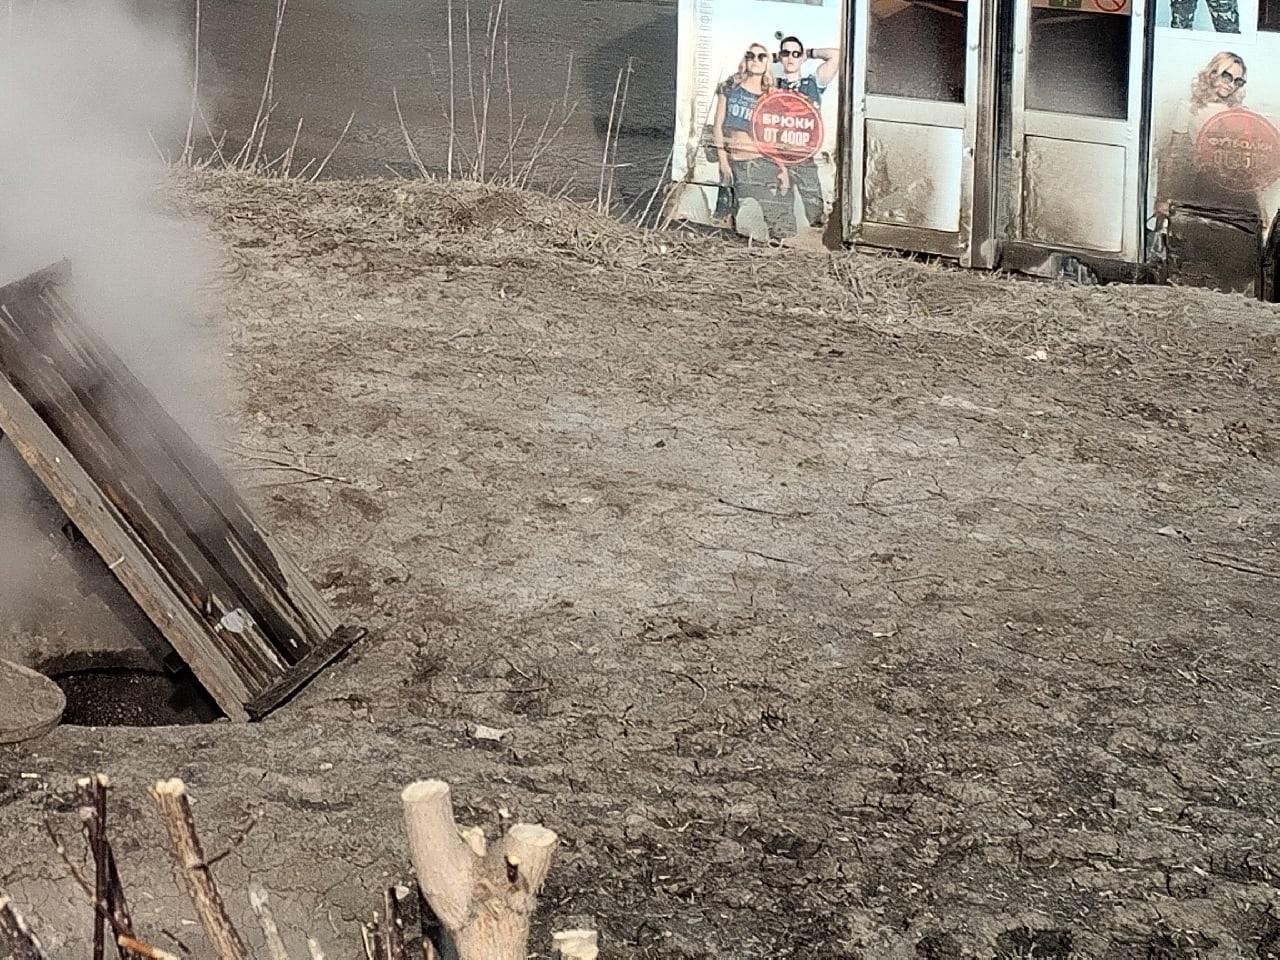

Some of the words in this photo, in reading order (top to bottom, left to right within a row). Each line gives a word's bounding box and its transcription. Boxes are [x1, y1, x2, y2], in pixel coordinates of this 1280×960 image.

[763, 113, 814, 130] БРЮКИ
[763, 128, 780, 143] ОТ
[780, 129, 810, 147] 400Р
